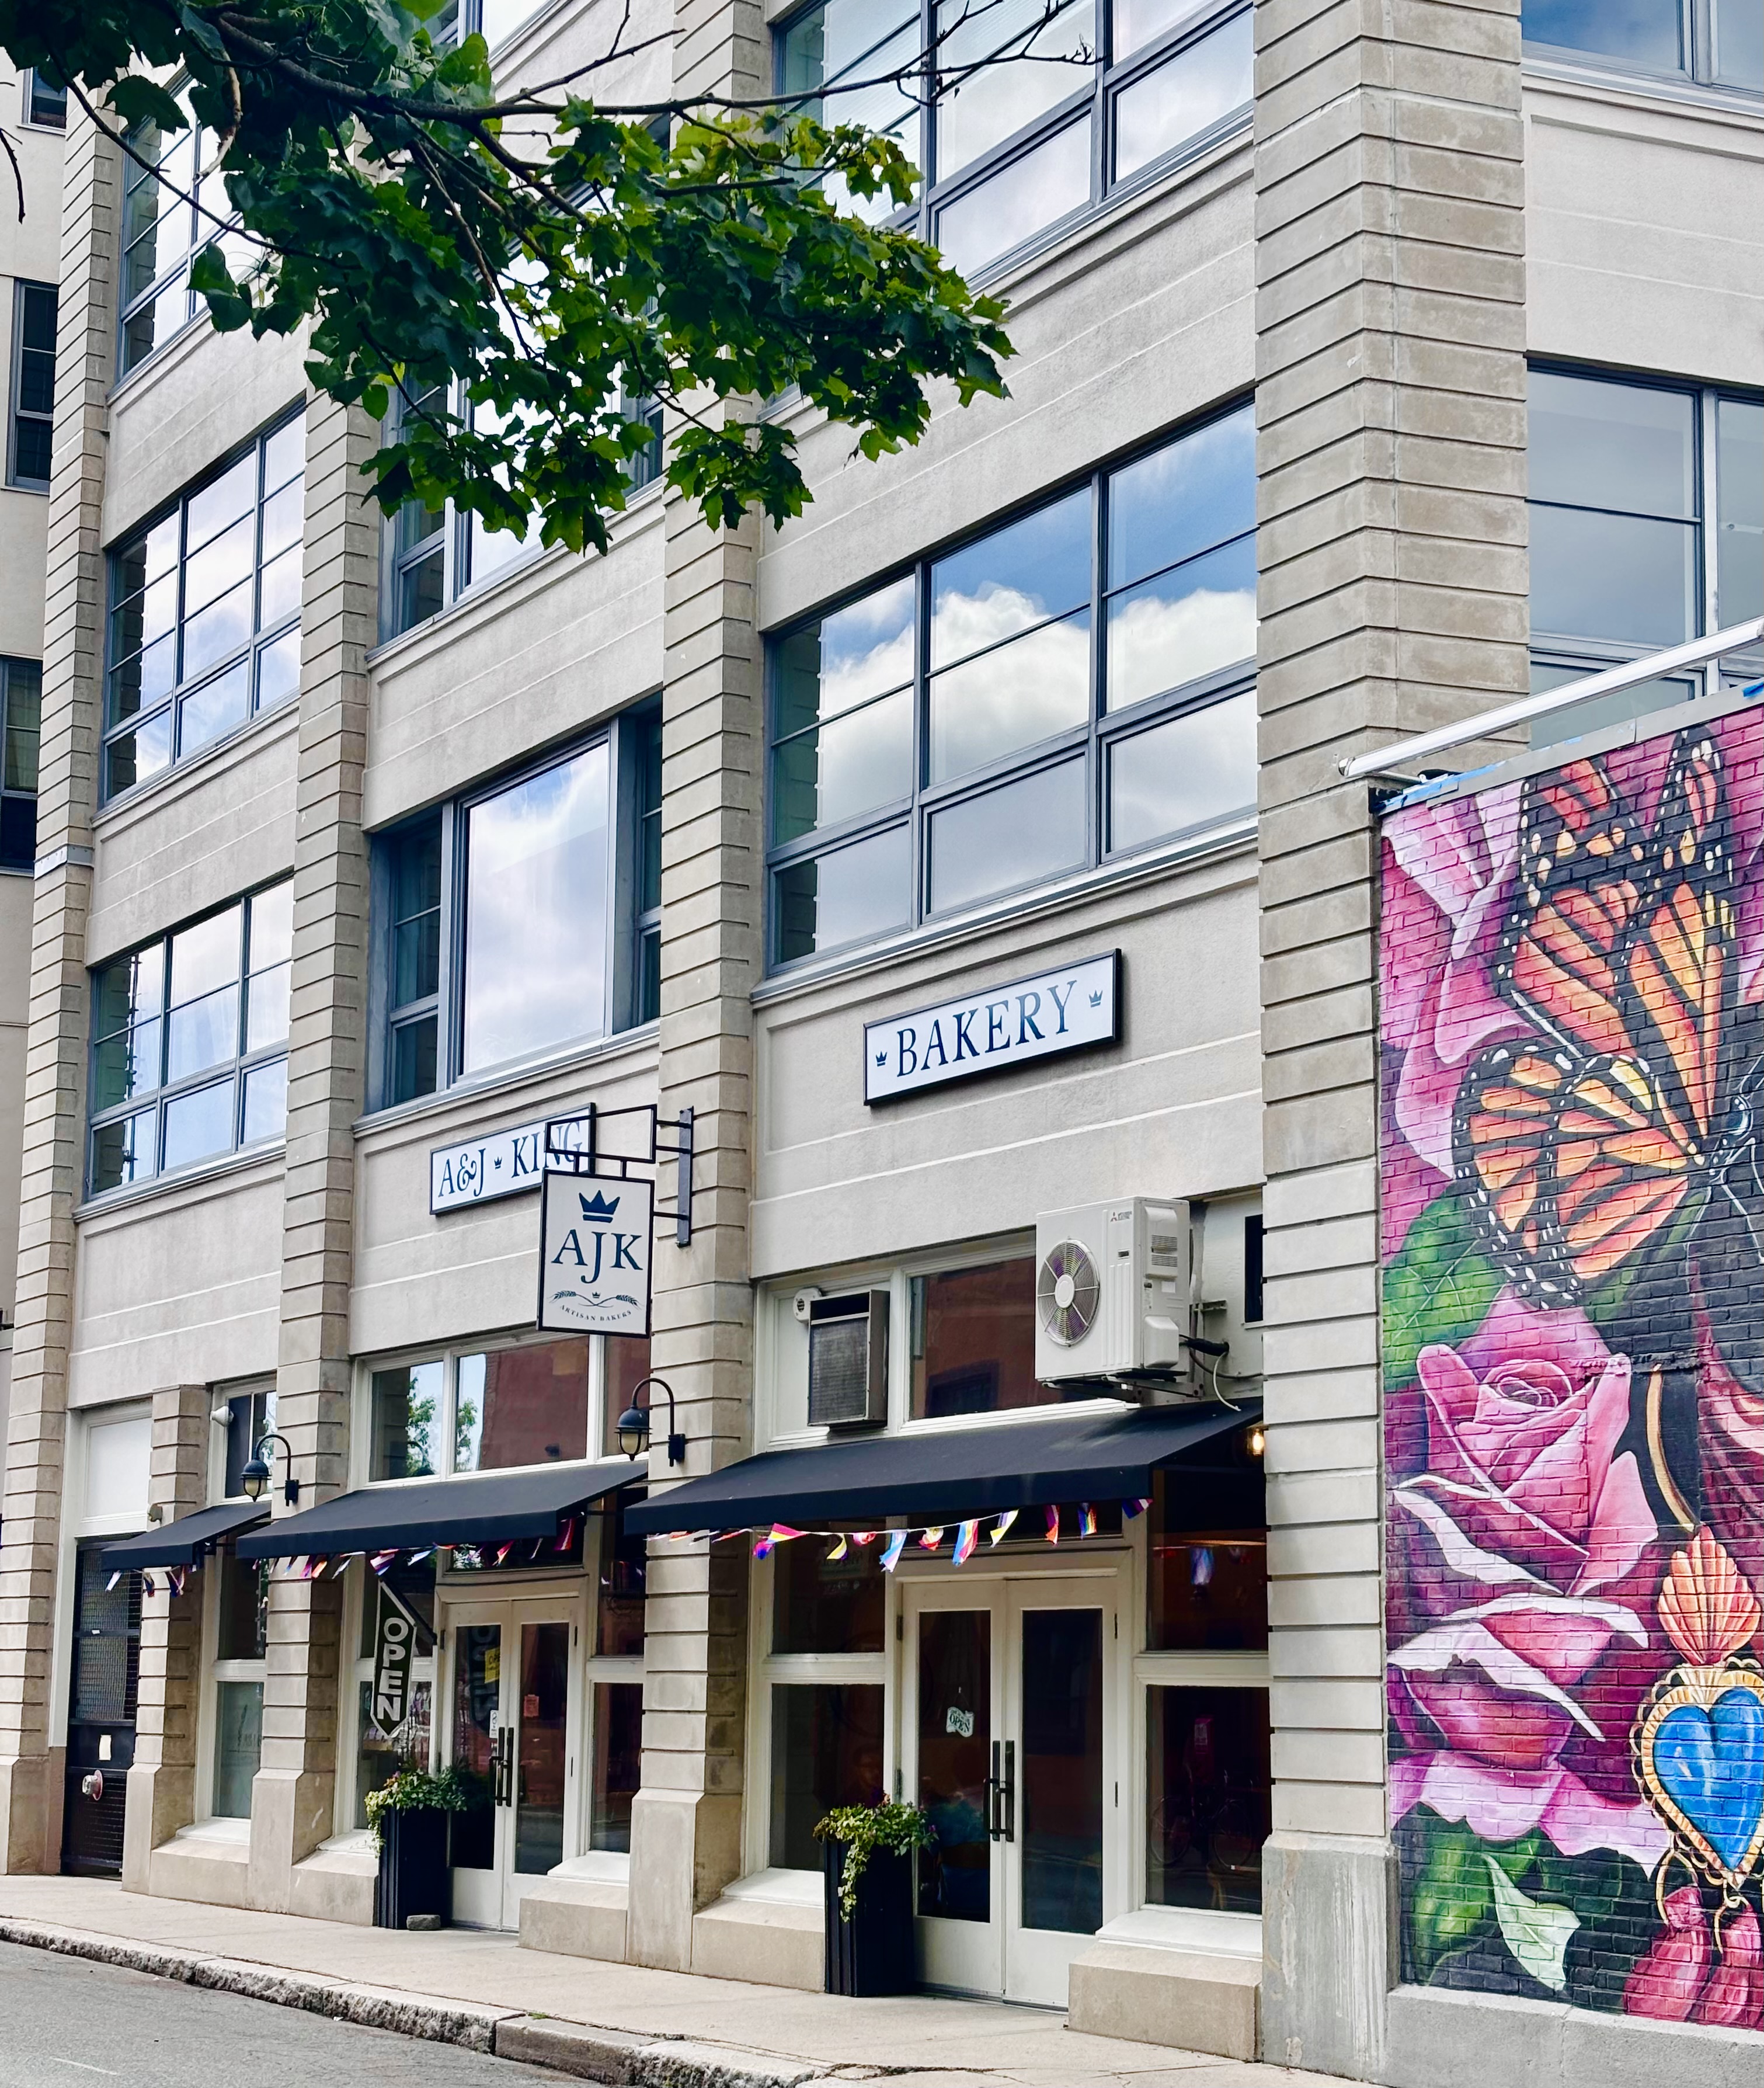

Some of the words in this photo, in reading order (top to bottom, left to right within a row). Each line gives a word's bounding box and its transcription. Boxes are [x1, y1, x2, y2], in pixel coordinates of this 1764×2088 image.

[897, 979, 1077, 1077] BAKERY
[438, 1148, 486, 1197] A&J
[511, 1121, 582, 1178] KING
[551, 1229, 643, 1284] AJK
[559, 1304, 596, 1321] ARTISAN
[600, 1310, 632, 1322] BAKERS
[377, 1617, 409, 1721] OPEN
[949, 1713, 970, 1733] OPEN
